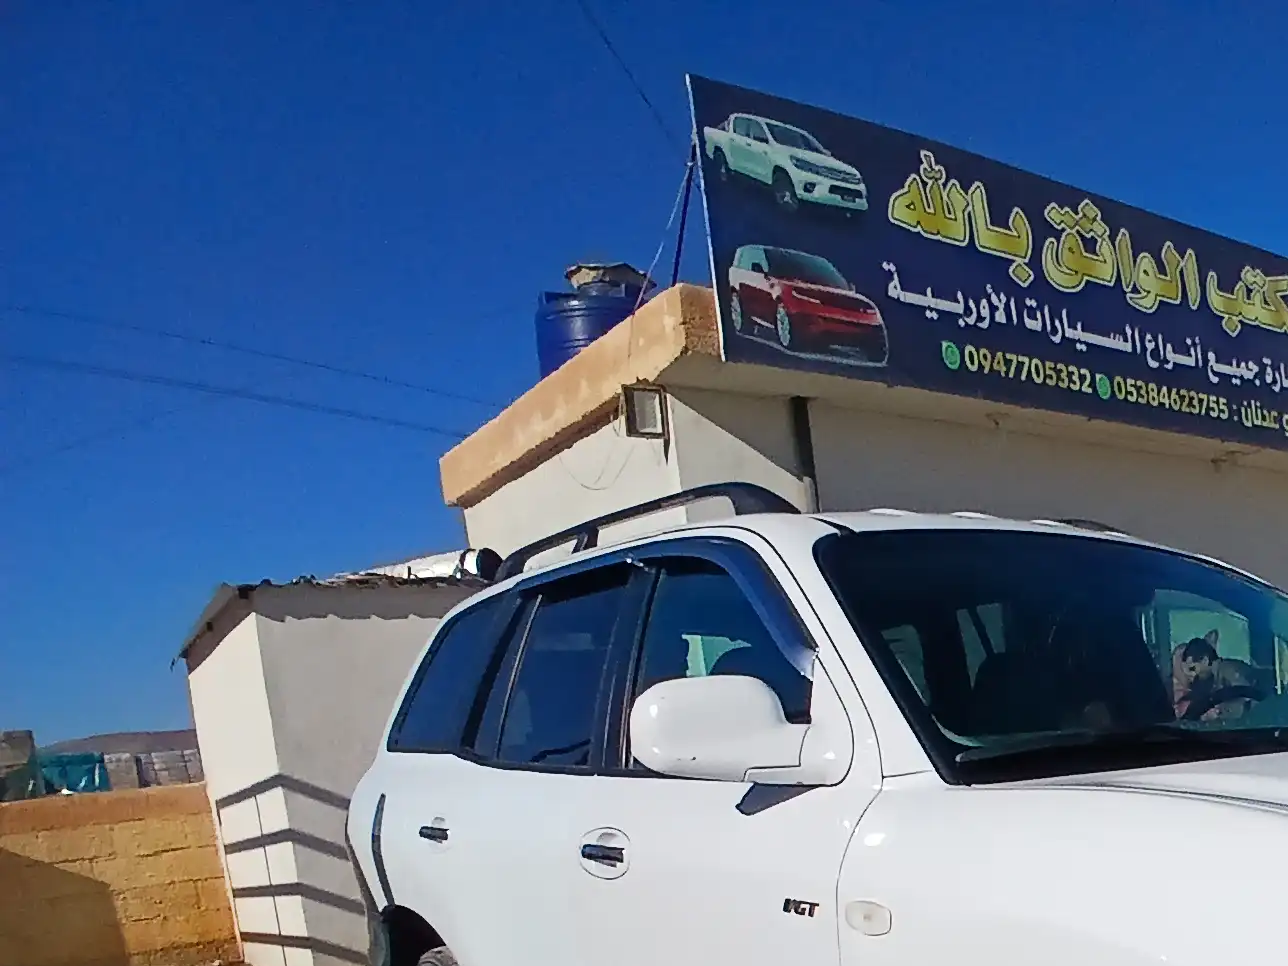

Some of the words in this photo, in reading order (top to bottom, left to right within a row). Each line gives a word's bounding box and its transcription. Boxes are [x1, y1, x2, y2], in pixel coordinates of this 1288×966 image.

[888, 150, 1034, 288] بالله
[1042, 200, 1200, 313] الواثق
[882, 261, 1018, 329] الأوربية
[1023, 297, 1140, 354] السيارات
[1145, 332, 1202, 370] أنواع
[964, 344, 1093, 394] 0947705332
[1208, 351, 1259, 386] جميع
[1113, 376, 1229, 420] 05384623755
